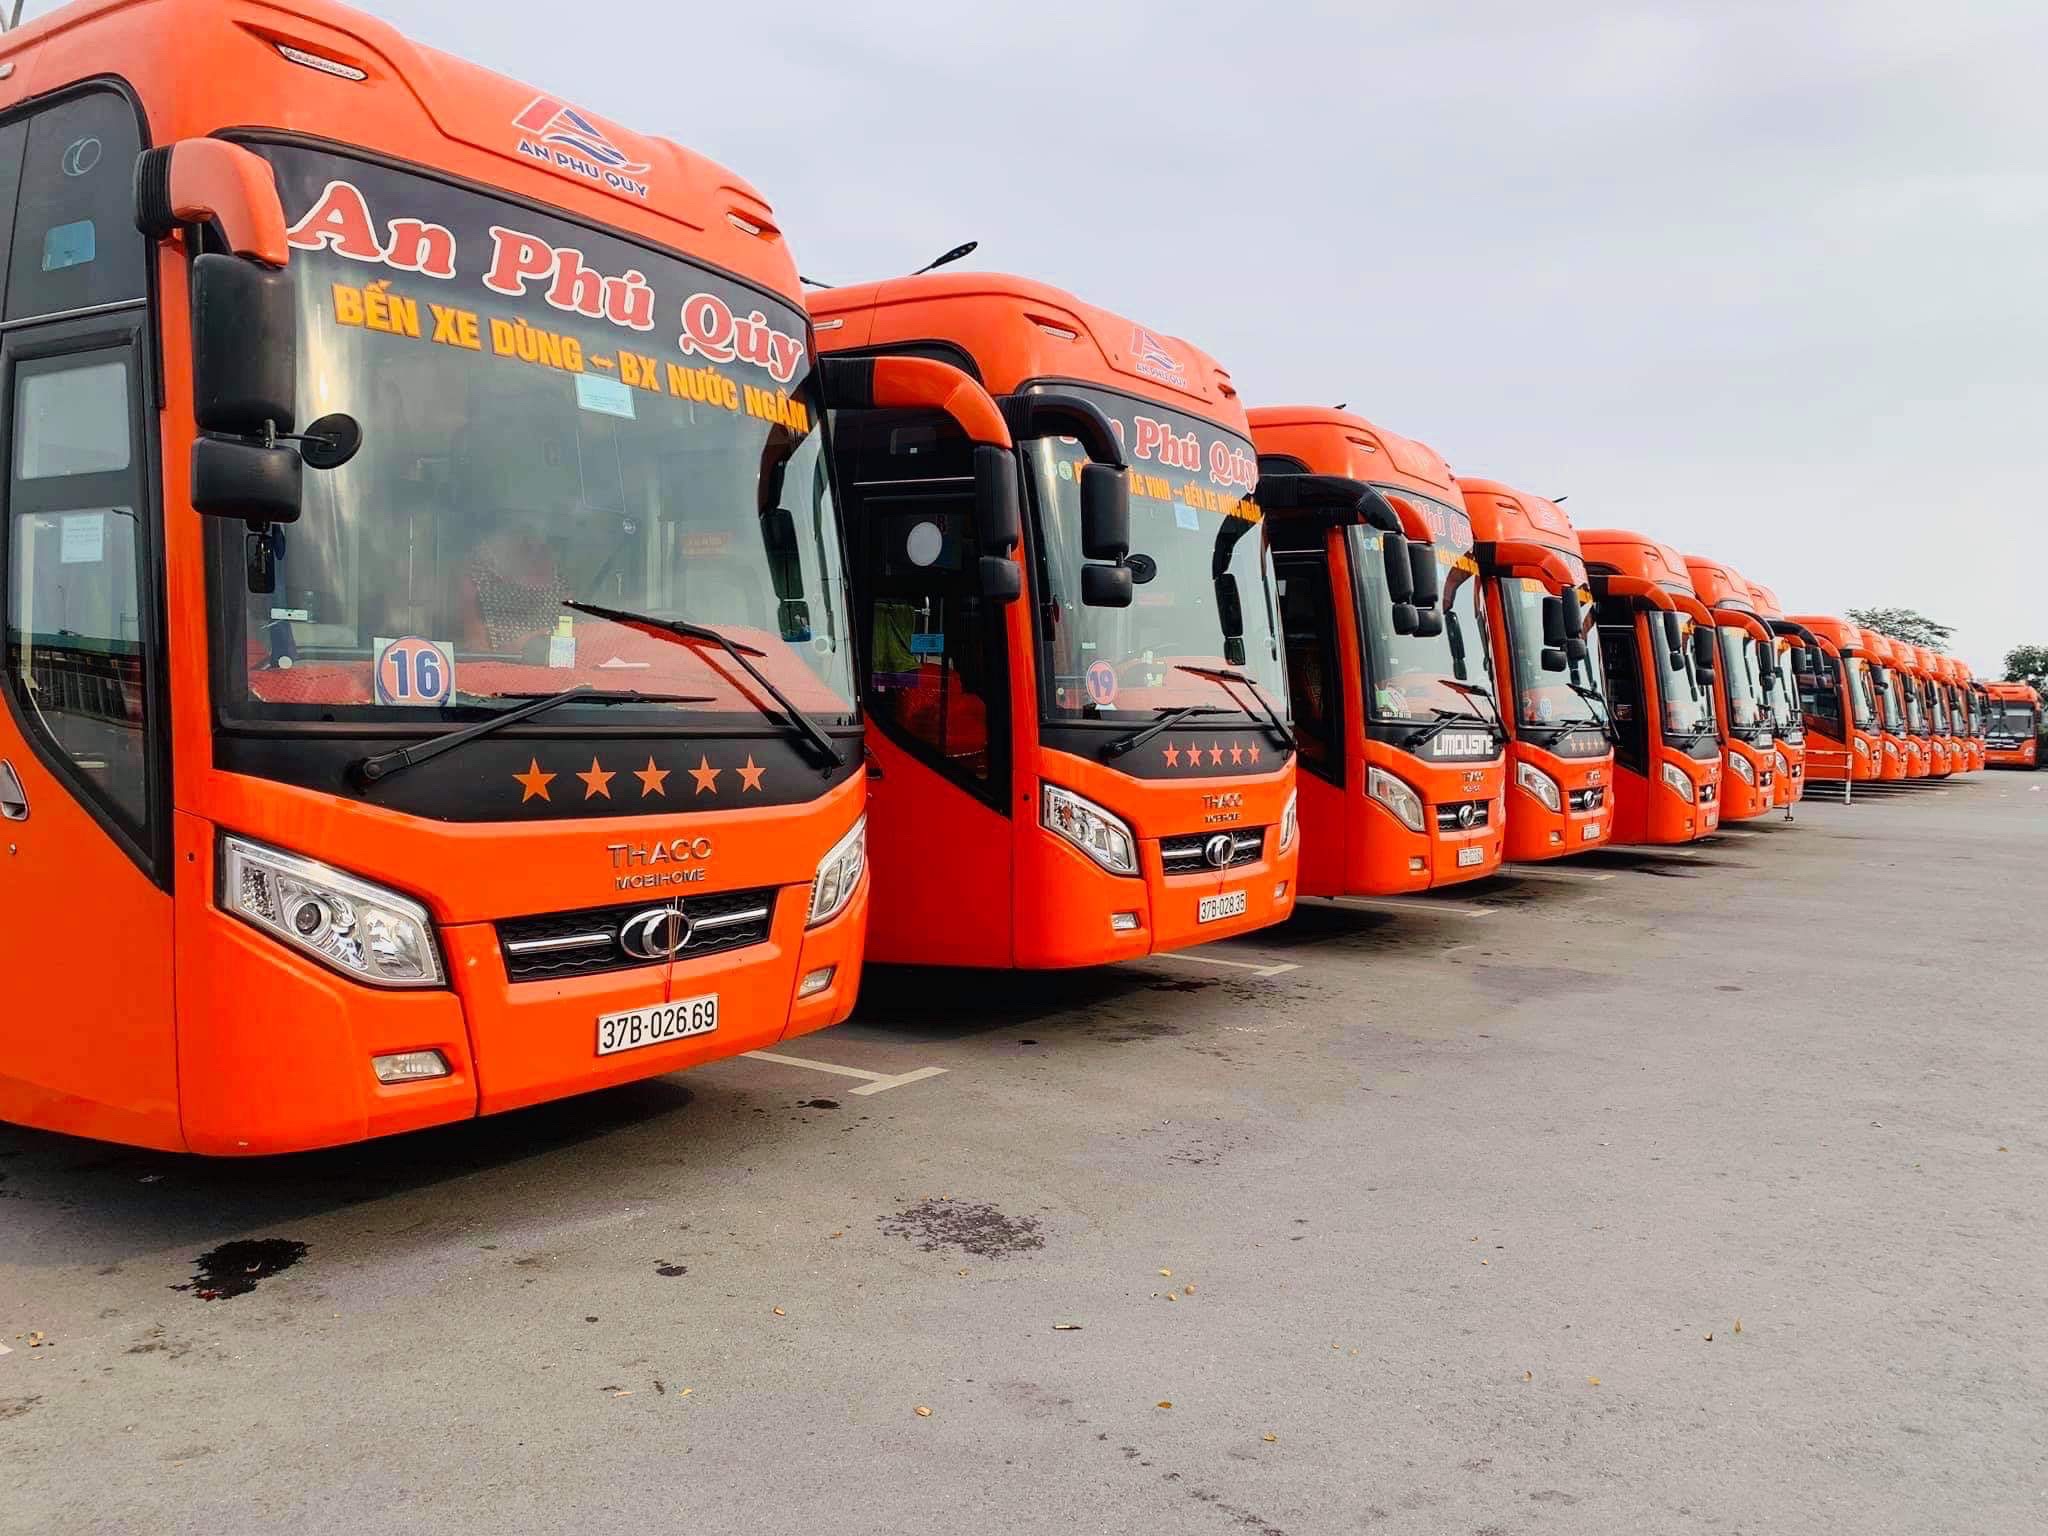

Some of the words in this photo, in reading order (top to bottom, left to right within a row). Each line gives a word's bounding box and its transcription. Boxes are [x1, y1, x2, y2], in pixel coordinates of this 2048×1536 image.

[518, 140, 551, 161] AN
[555, 152, 600, 179] PHU
[604, 171, 648, 198] QUY
[287, 180, 456, 280] An
[483, 225, 655, 332] Phú
[331, 278, 422, 339] BẾN
[427, 302, 482, 351] XE
[488, 314, 585, 374] DÙNG
[616, 350, 662, 393] BX
[665, 362, 739, 411] NƯỚC
[1135, 416, 1201, 471] Phú
[389, 648, 441, 699] 16
[1089, 671, 1113, 698] 19
[1432, 734, 1494, 756] LIMOUSINE
[608, 837, 712, 868] THACO
[615, 867, 706, 890] MOBIHOME
[603, 1000, 715, 1049] 37B-026.69
